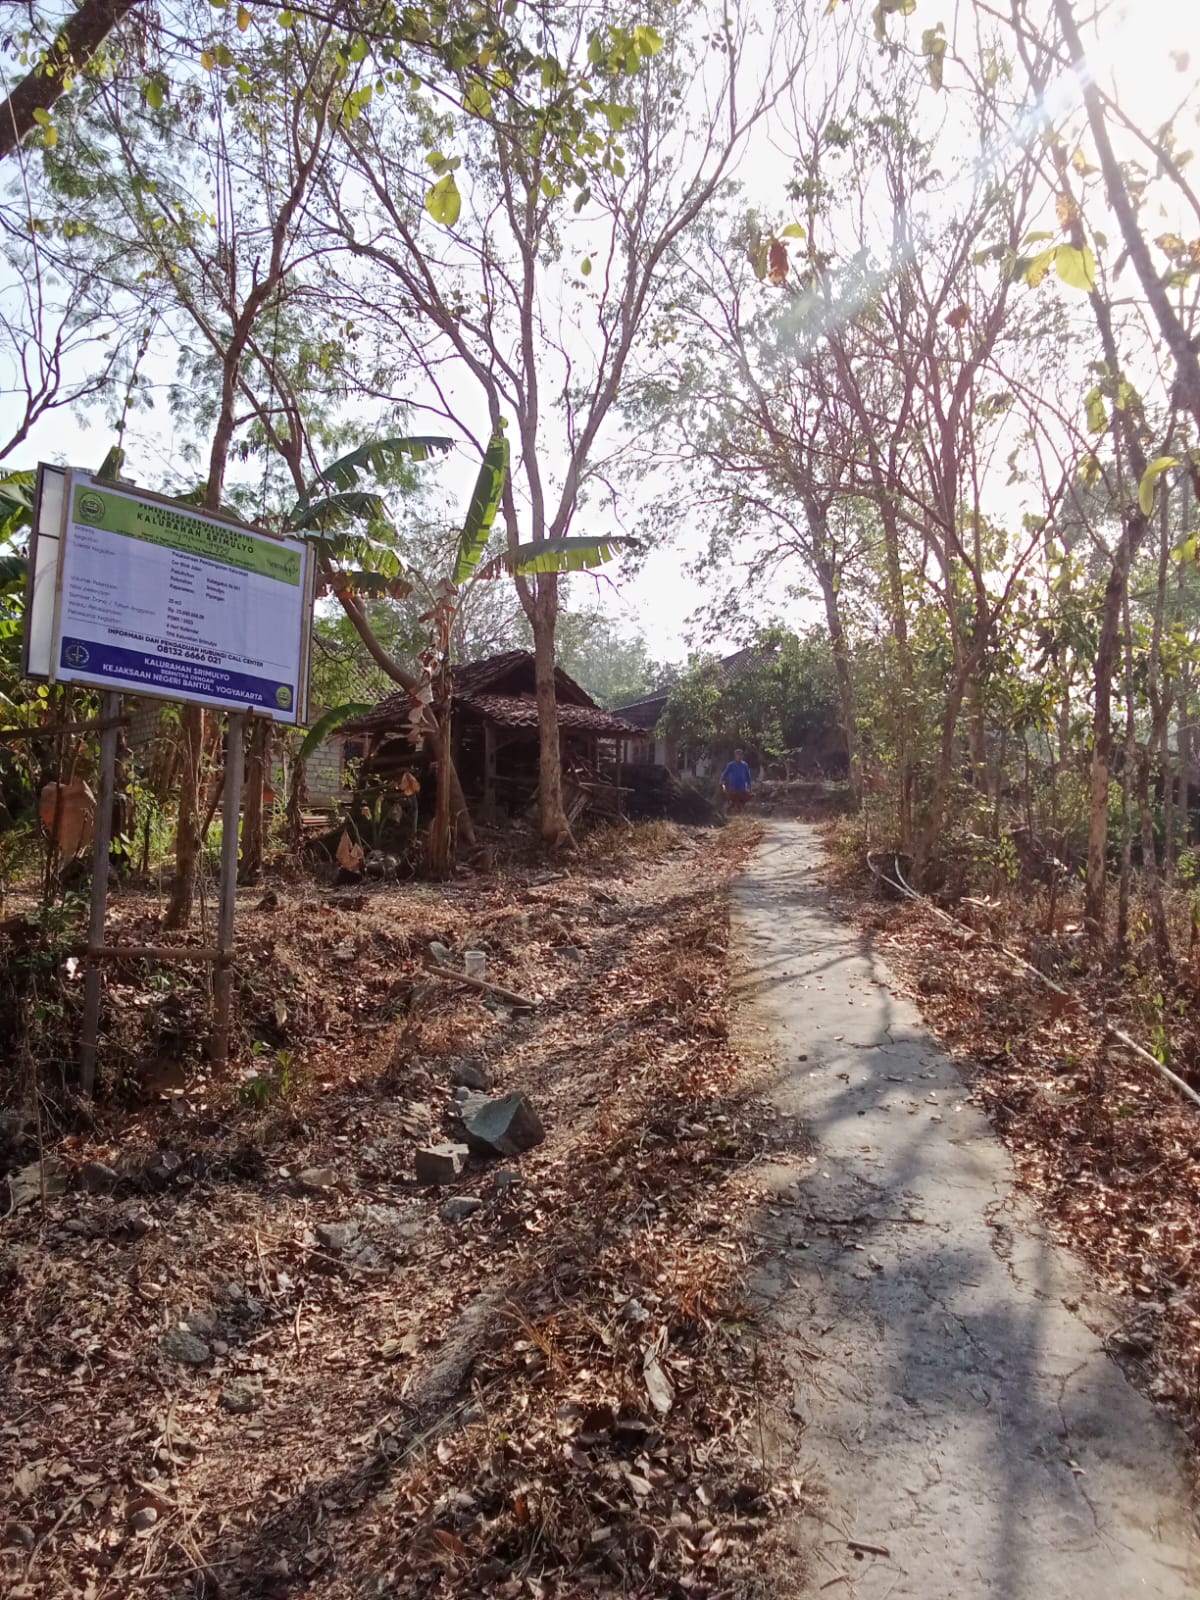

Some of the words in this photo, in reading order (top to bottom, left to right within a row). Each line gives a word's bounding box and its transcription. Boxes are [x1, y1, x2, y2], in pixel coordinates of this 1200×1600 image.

[136, 511, 200, 538] KALURAHAN
[206, 532, 254, 553] SRIMULYO
[107, 627, 144, 640] INFORMASI
[144, 635, 159, 644] DAN
[160, 639, 199, 653] PENGADUAN
[200, 648, 226, 658] HUBUNGI
[227, 654, 241, 662] CALL
[242, 657, 263, 667] CENTER
[156, 643, 183, 656] 08132
[184, 650, 206, 661] 6666
[207, 655, 221, 665] 021
[102, 662, 151, 680] KEJAKSAAN
[153, 672, 181, 686] NEGERI
[181, 678, 214, 692] BANTUL,
[215, 685, 263, 702] YOGYAKARTA
[143, 656, 191, 674] KALURAHAN
[193, 666, 230, 682] SRIMULYO
